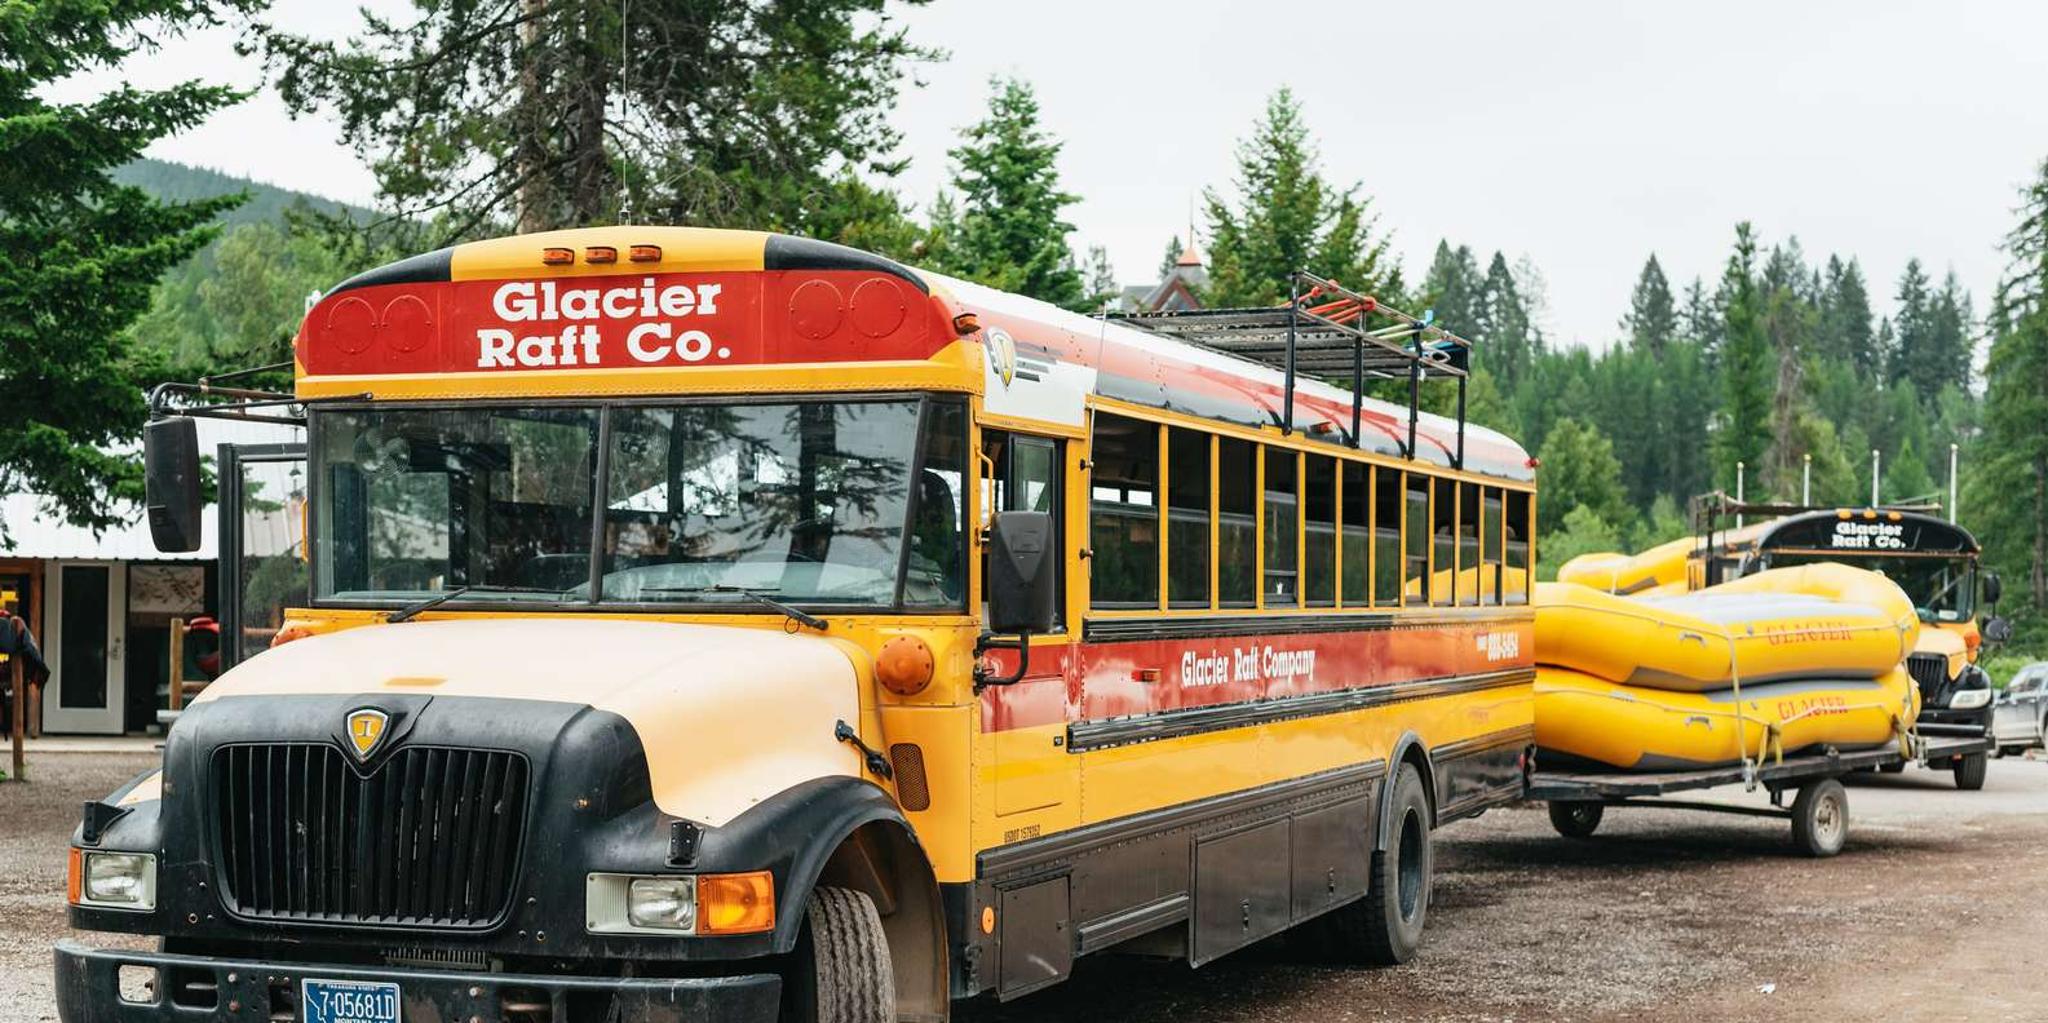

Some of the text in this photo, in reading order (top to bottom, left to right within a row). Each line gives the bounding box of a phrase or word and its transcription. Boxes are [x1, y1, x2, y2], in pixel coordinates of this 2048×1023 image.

[493, 278, 721, 322] Glacier
[477, 322, 731, 367] Raft Co.
[1832, 533, 1906, 548] Raft Co.
[1836, 522, 1903, 536] Glacier
[1766, 622, 1852, 646] GLACIER
[1181, 645, 1316, 687] Glacier Raft Company
